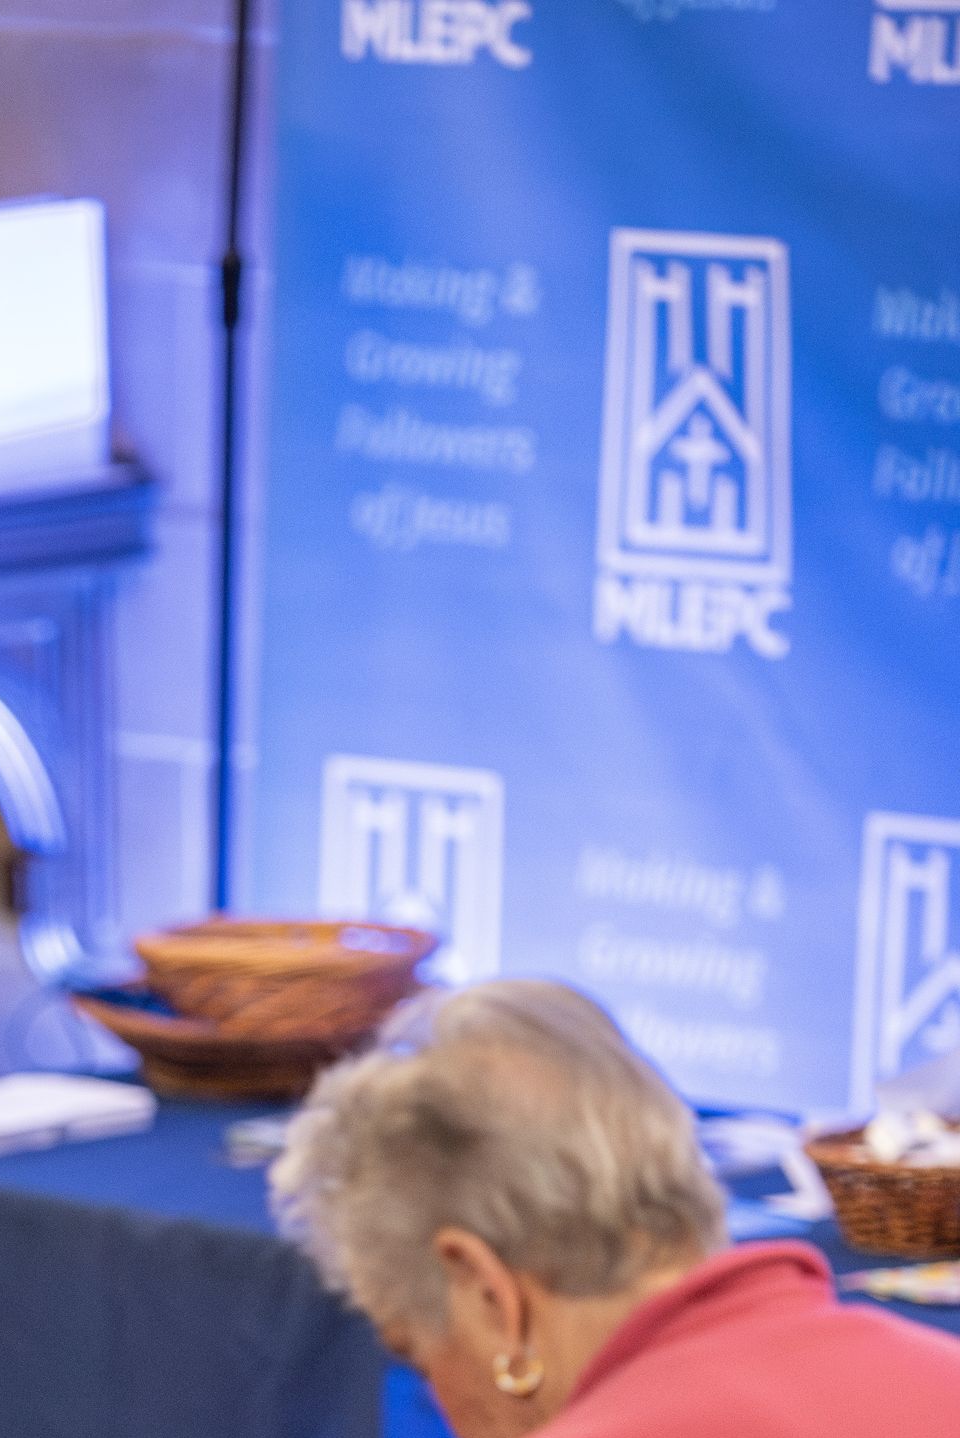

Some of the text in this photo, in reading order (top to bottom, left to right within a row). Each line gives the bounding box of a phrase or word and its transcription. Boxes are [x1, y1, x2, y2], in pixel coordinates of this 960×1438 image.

[868, 12, 960, 84] ML
[501, 261, 538, 317] &
[344, 329, 521, 407] Growing
[335, 403, 538, 476] Followers
[593, 577, 792, 659] MLEPC
[747, 863, 787, 922] &
[578, 921, 769, 1012] Growing
